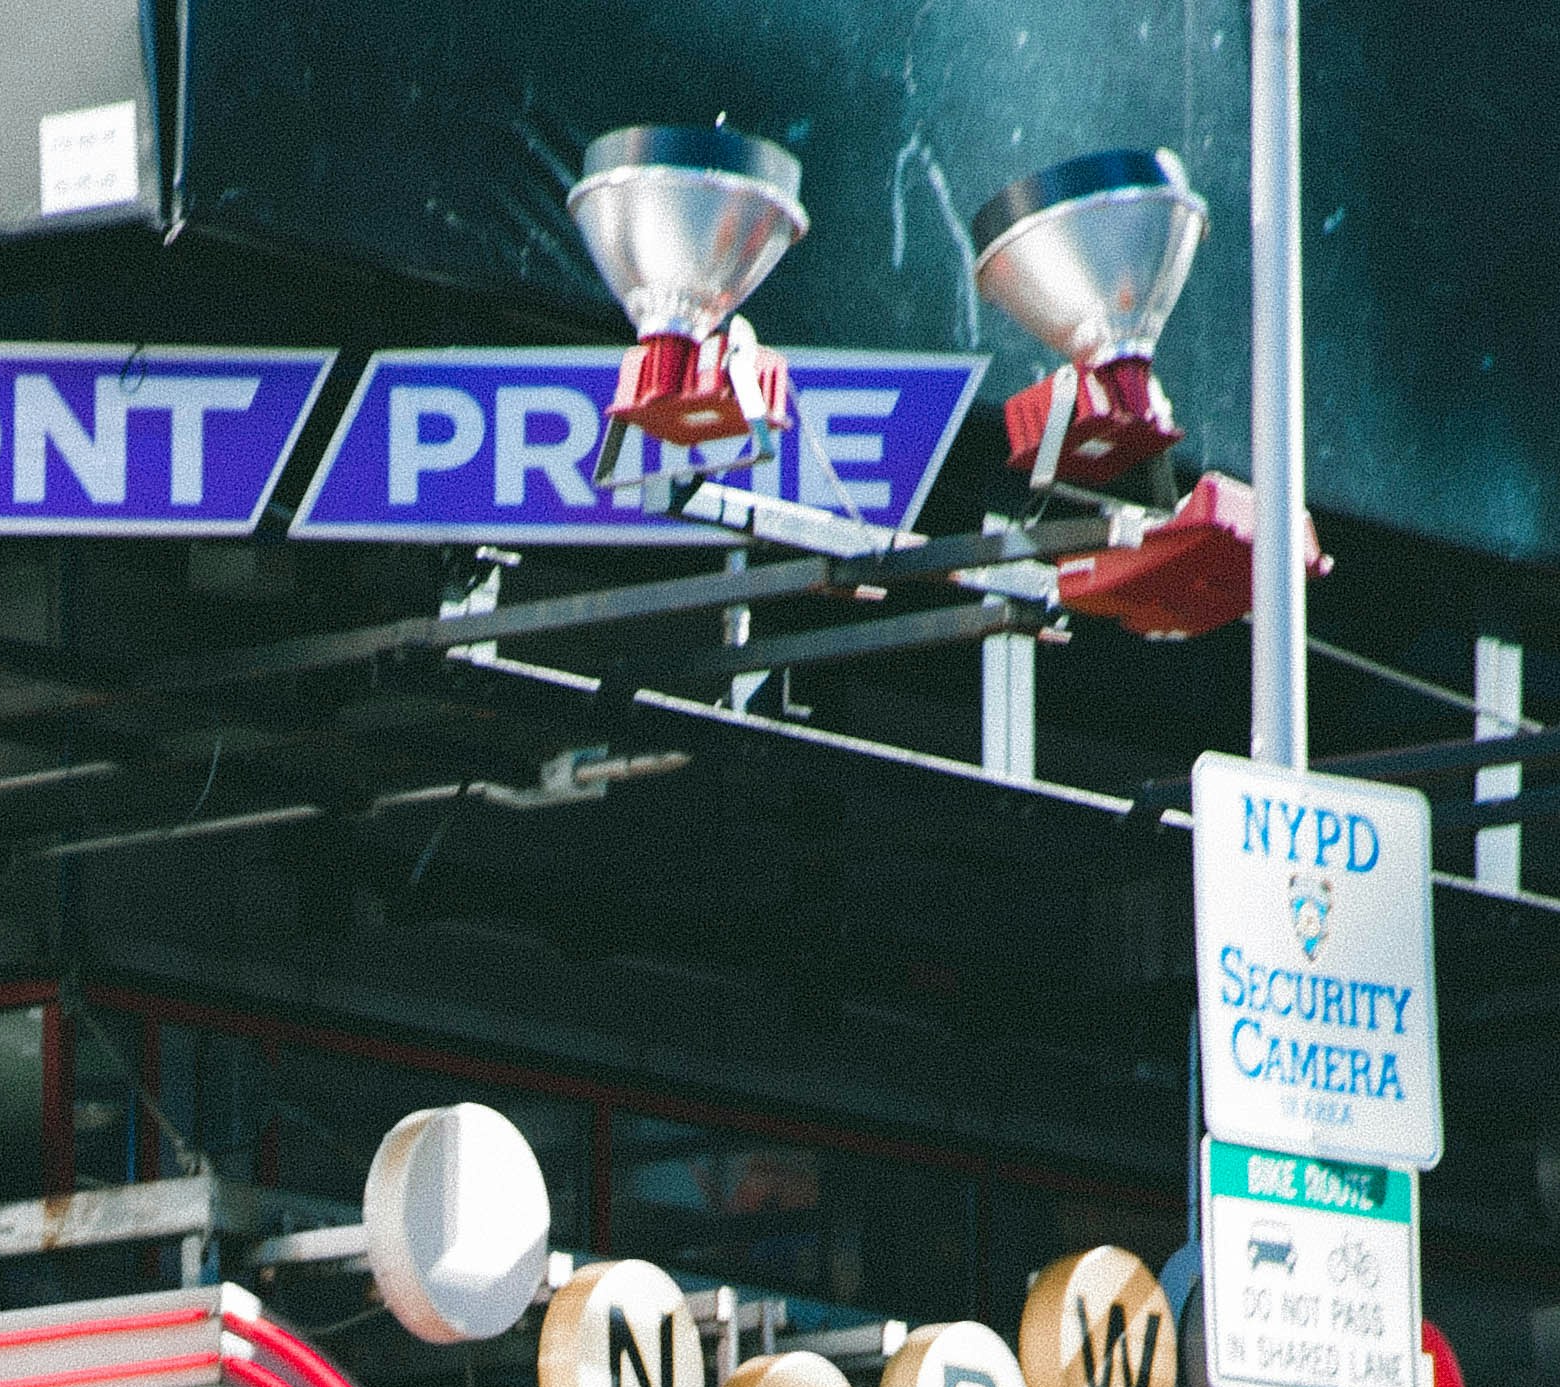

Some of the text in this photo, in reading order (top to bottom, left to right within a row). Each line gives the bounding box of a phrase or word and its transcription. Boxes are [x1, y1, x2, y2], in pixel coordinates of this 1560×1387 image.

[1241, 793, 1380, 874] NYPD
[1219, 945, 1413, 1036] SECURITY
[1231, 1016, 1407, 1101] CAMERA
[1247, 1154, 1298, 1200] BIKE
